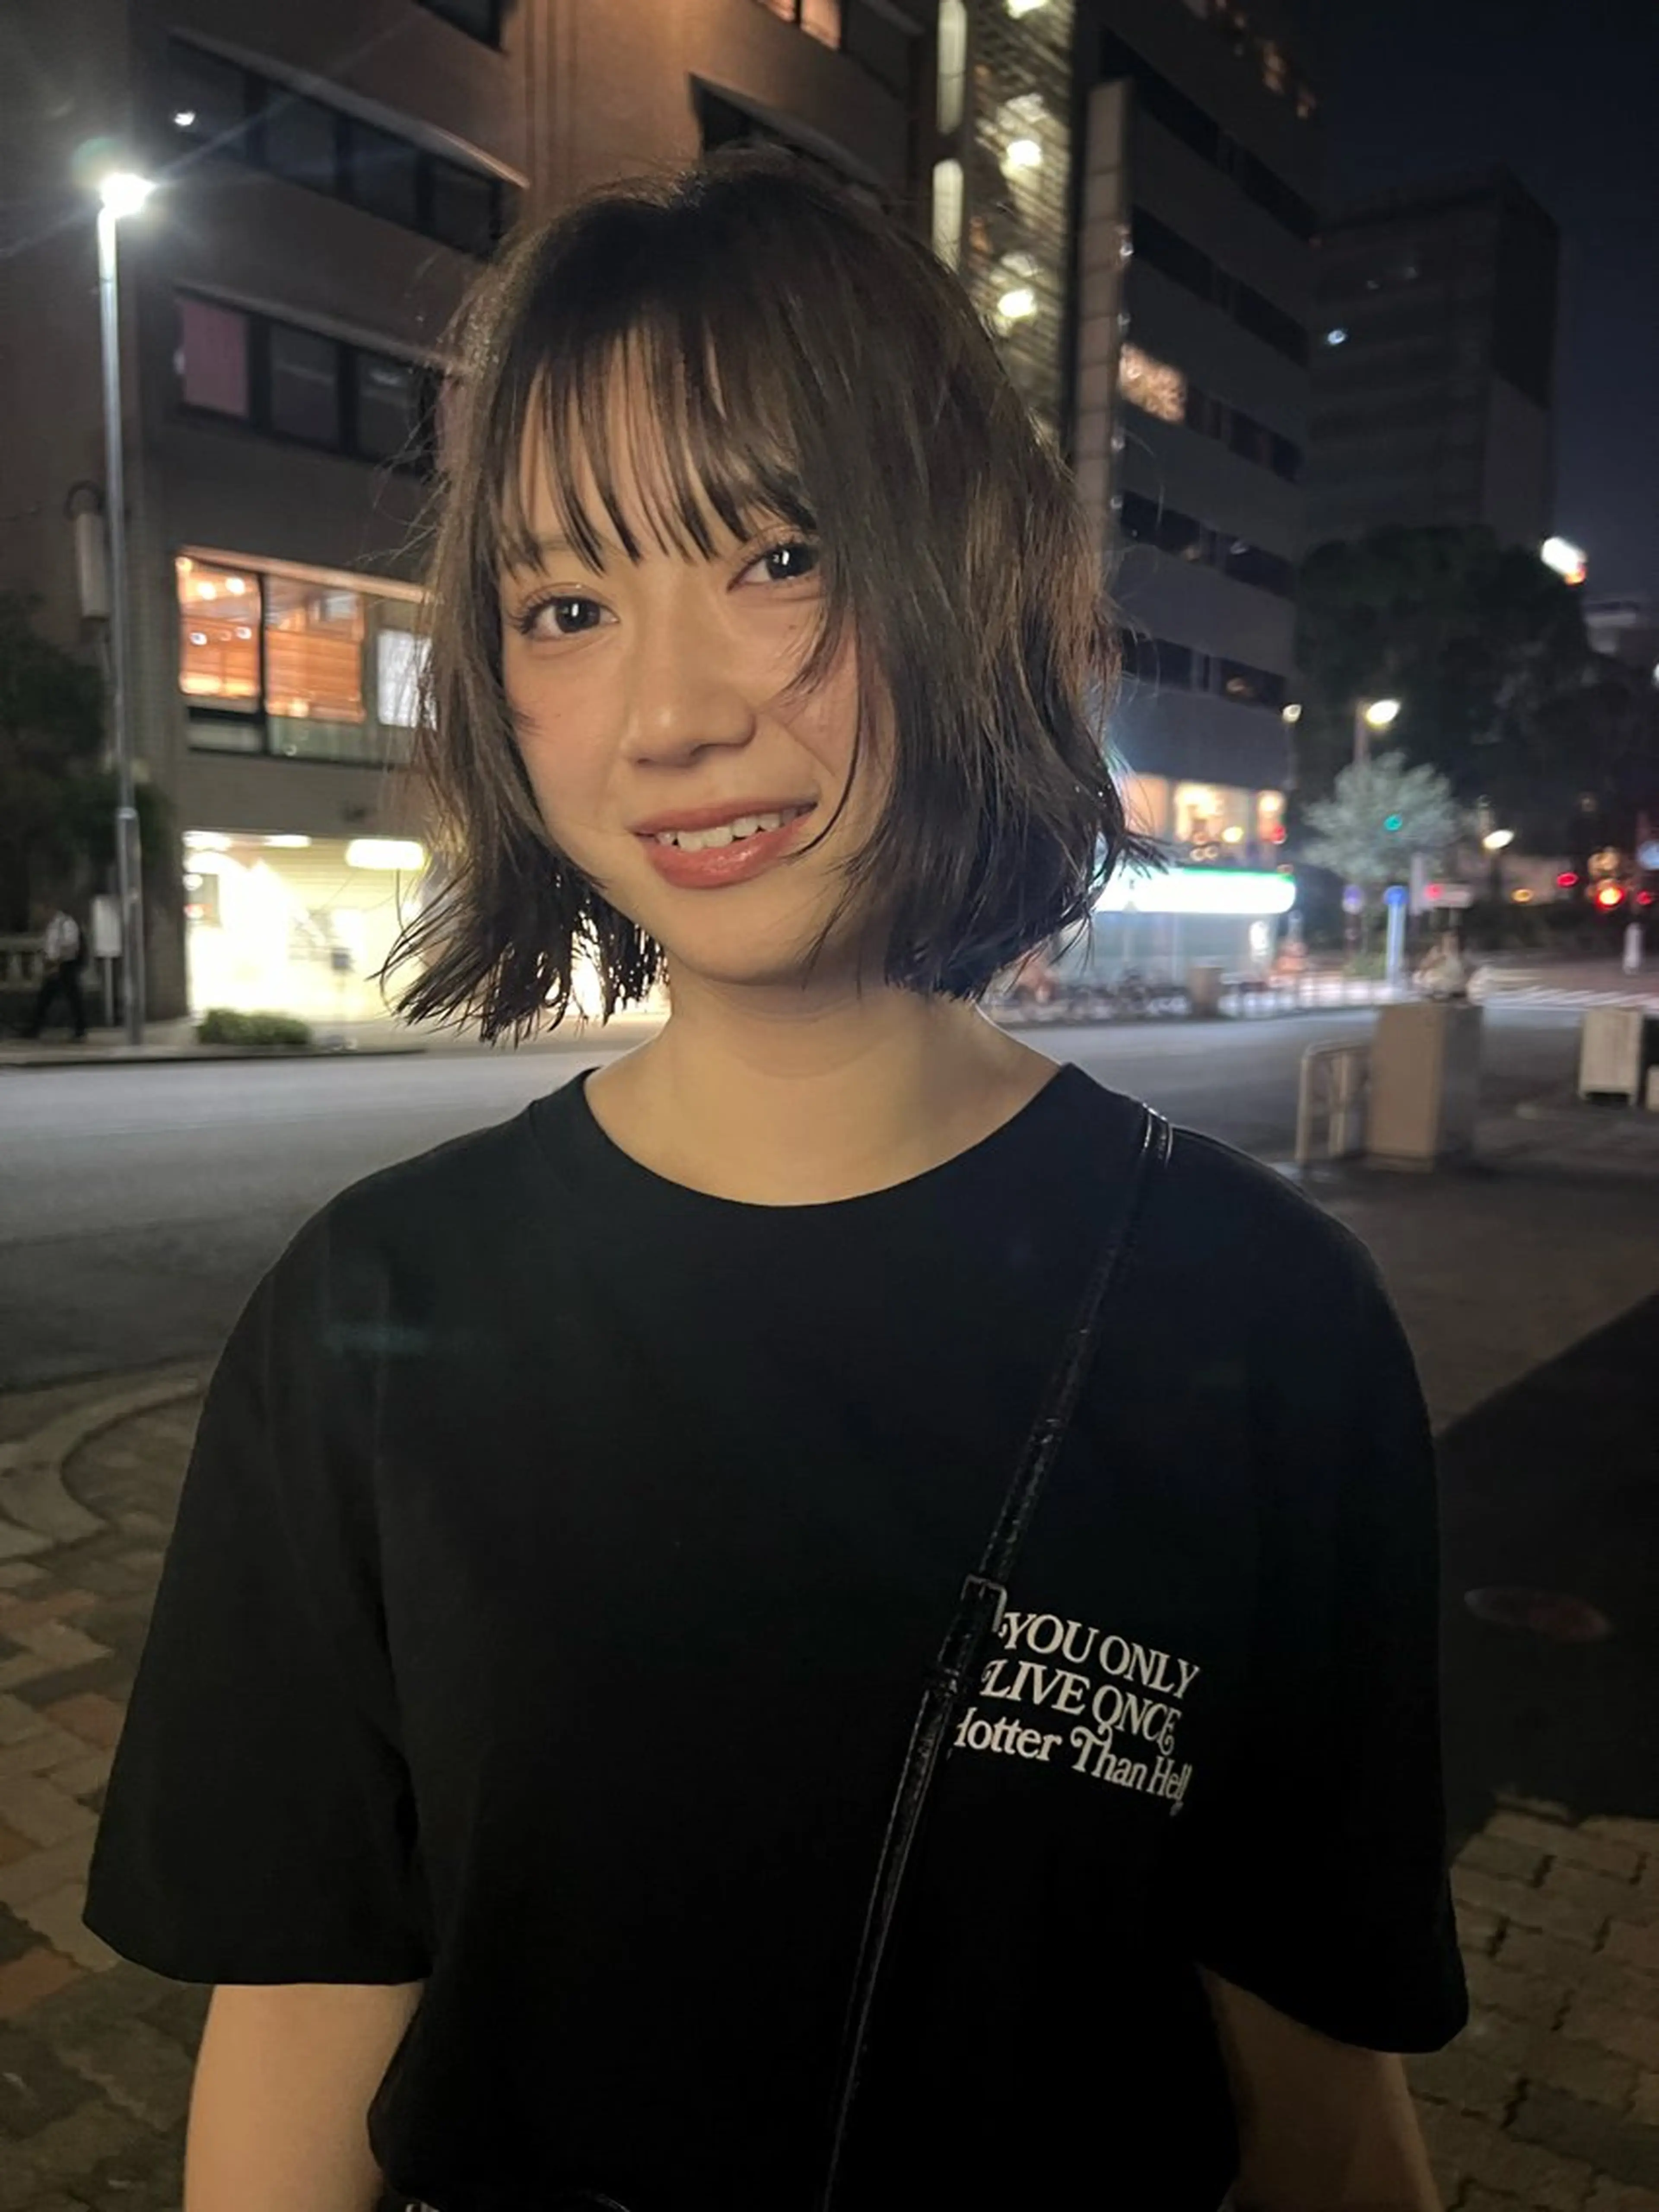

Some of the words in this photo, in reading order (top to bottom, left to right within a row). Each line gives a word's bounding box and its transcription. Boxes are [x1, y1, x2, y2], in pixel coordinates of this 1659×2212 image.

[998, 1611, 1100, 1663] YOU
[1099, 1635, 1200, 1698] ONLY
[979, 1659, 1090, 1715] LIVE
[1091, 1684, 1182, 1755] ONCE
[1070, 1725, 1147, 1790] Than
[1146, 1755, 1192, 1816] Hell
